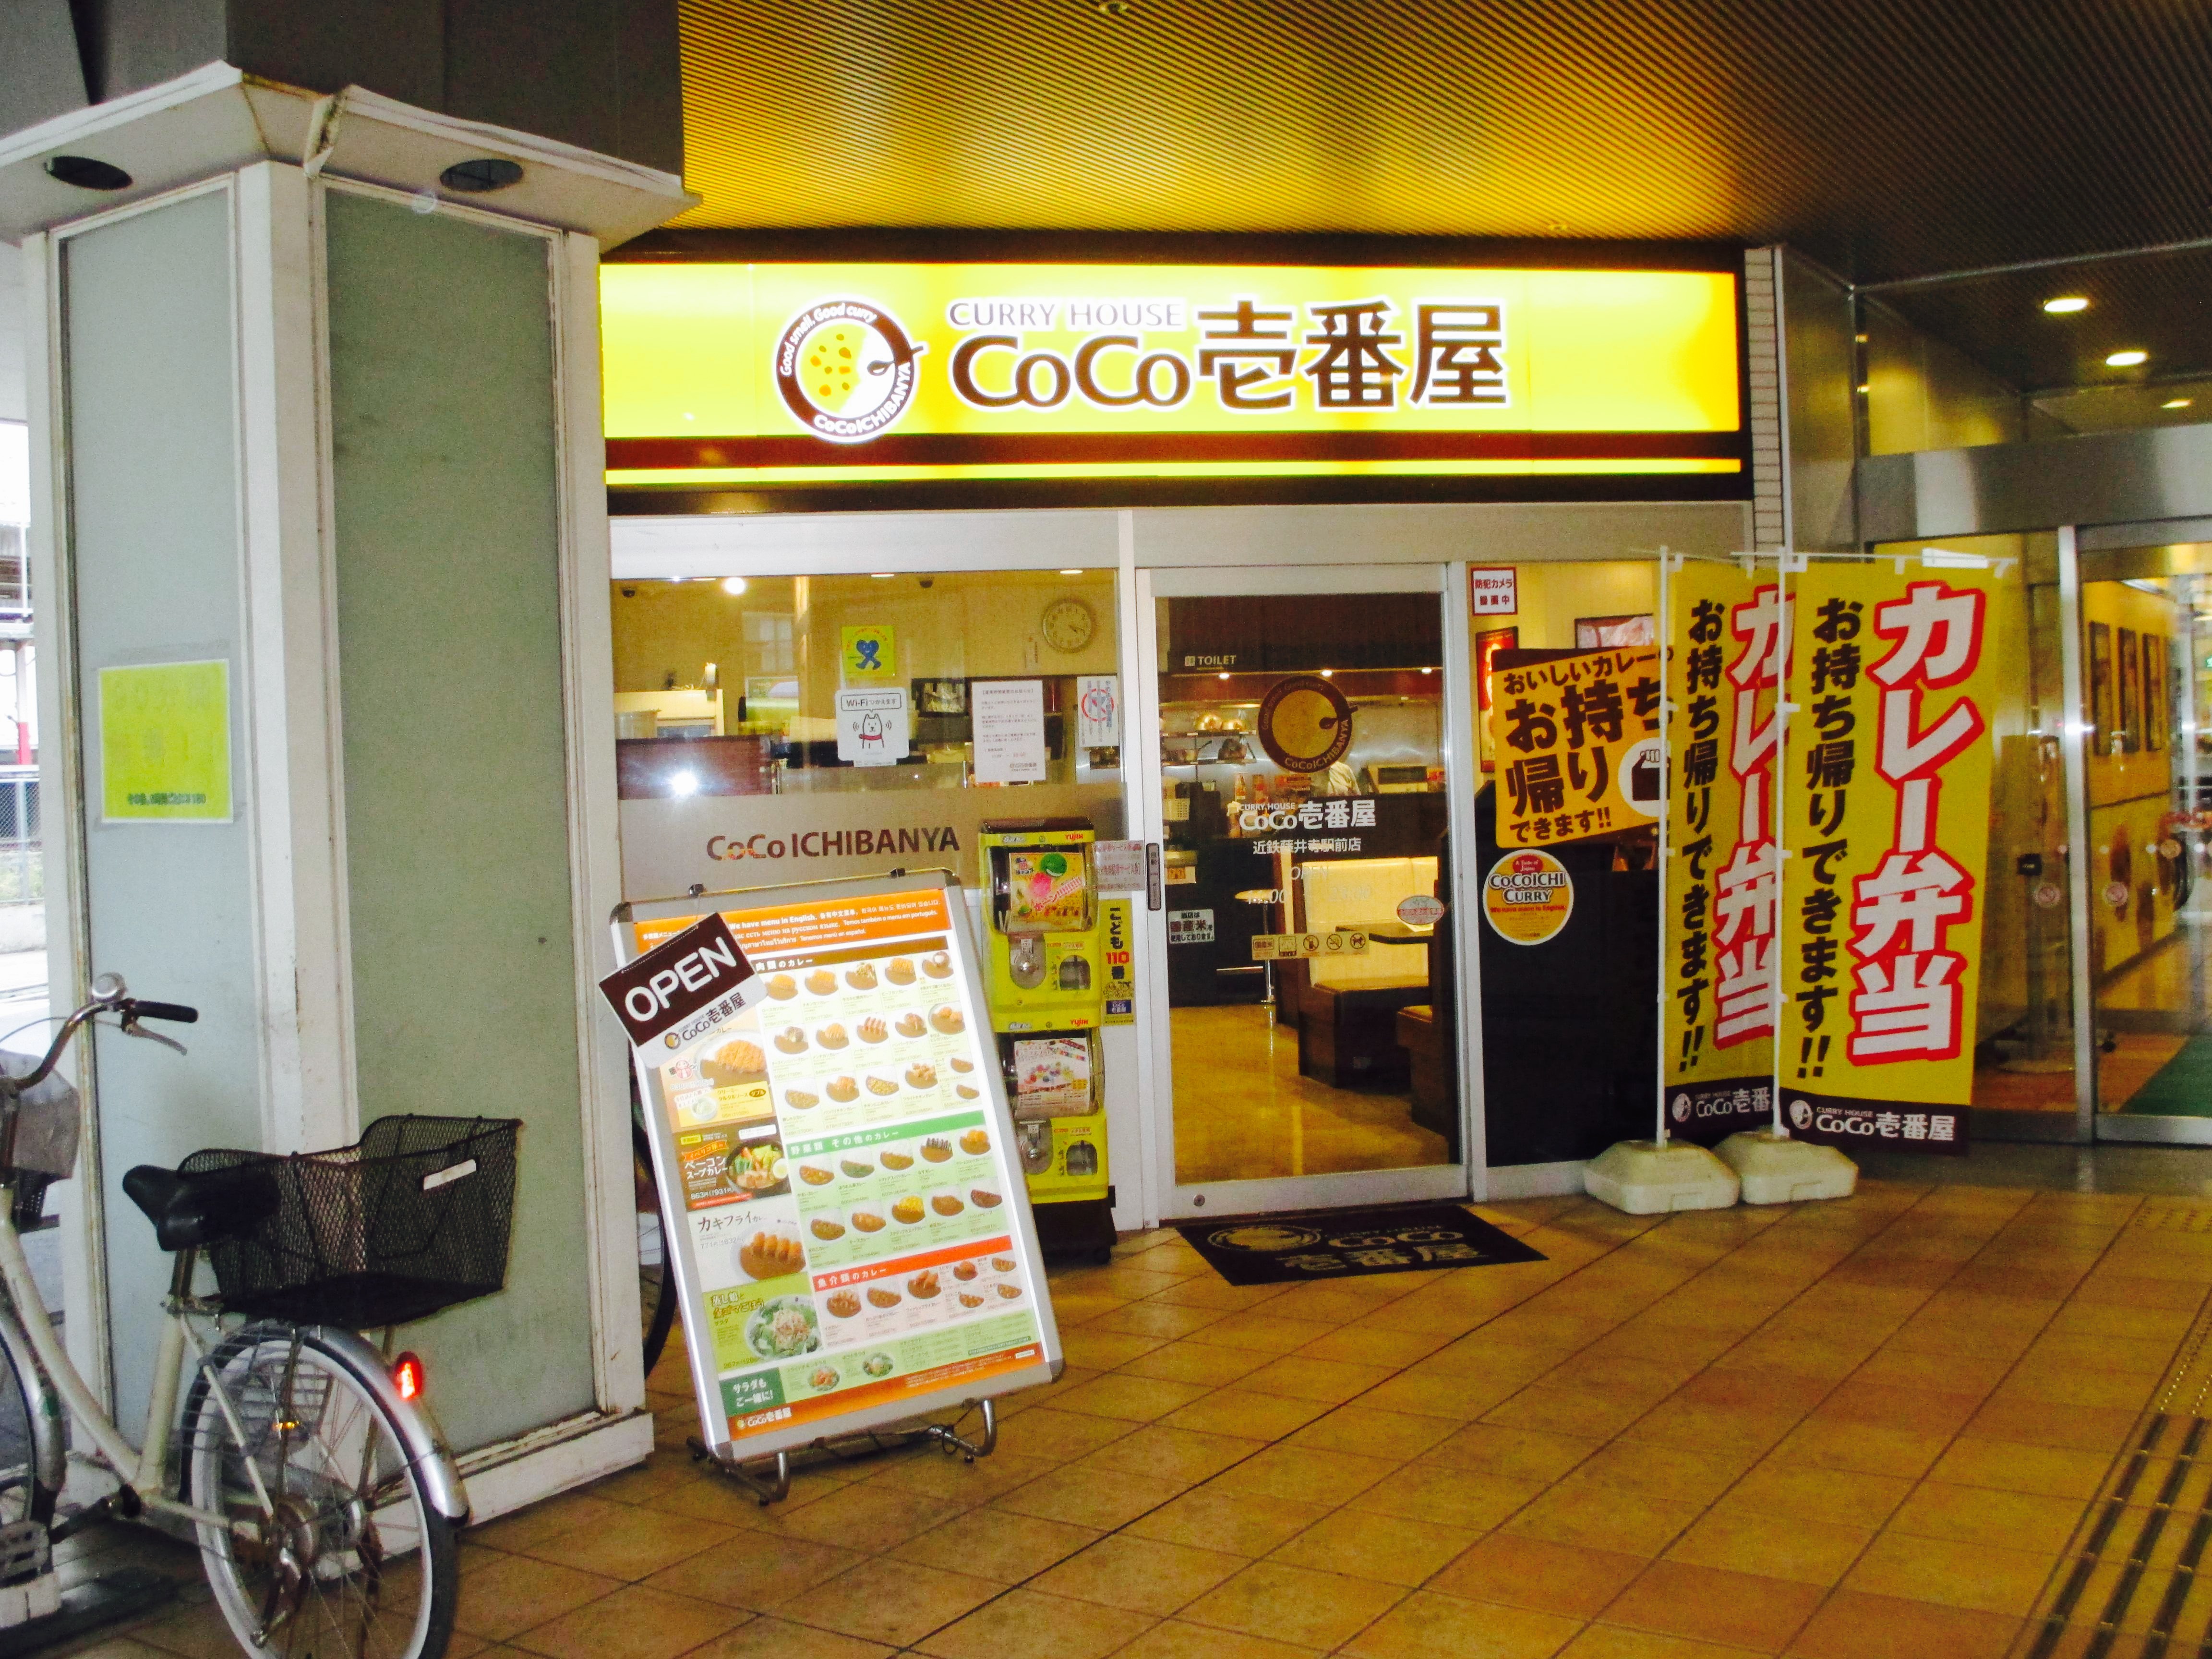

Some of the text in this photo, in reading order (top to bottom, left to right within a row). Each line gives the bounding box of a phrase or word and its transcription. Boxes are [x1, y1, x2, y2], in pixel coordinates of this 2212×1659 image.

[949, 302, 1182, 326] CURRY HOUSE
[780, 342, 795, 376] Good
[813, 302, 846, 322] Good
[847, 306, 878, 323] curry
[951, 300, 1507, 409] CoCo壱番屋
[1475, 578, 1513, 589] 防犯カメラ
[1197, 655, 1237, 666] TOILET
[1503, 645, 1674, 696] おいしいカレーの
[846, 697, 897, 707] Wi-Fiつかえます
[1505, 676, 1673, 754] お持ち
[1506, 746, 1609, 819] 帰り
[1239, 799, 1377, 830] CoCo壱番屋
[1267, 802, 1296, 810] HOUSE
[1712, 582, 1794, 1051] カレー弁当
[1846, 578, 1986, 1068] カレー弁当
[1253, 837, 1361, 854] 近鉄藤井寺駅前店
[1290, 866, 1329, 880] OPEN
[742, 921, 759, 929] have
[761, 918, 780, 926] menu
[789, 913, 817, 923] English.
[861, 916, 882, 925] também
[911, 910, 938, 920] português.
[792, 925, 818, 935] русском
[755, 958, 813, 972] 肉類のカレー
[625, 936, 737, 1022] OPEN
[682, 991, 746, 1041] CoCo壱番屋
[1695, 1086, 1773, 1118] CoCo壱番
[1816, 1106, 1874, 1118] CURRY HOUSE
[1815, 1111, 1956, 1142] CoCo壱番屋
[831, 1131, 899, 1148] その他のカレー
[684, 1156, 726, 1170] ベーコン
[686, 1166, 729, 1180] スープカレー
[817, 1268, 887, 1288] 魚介類のカレー
